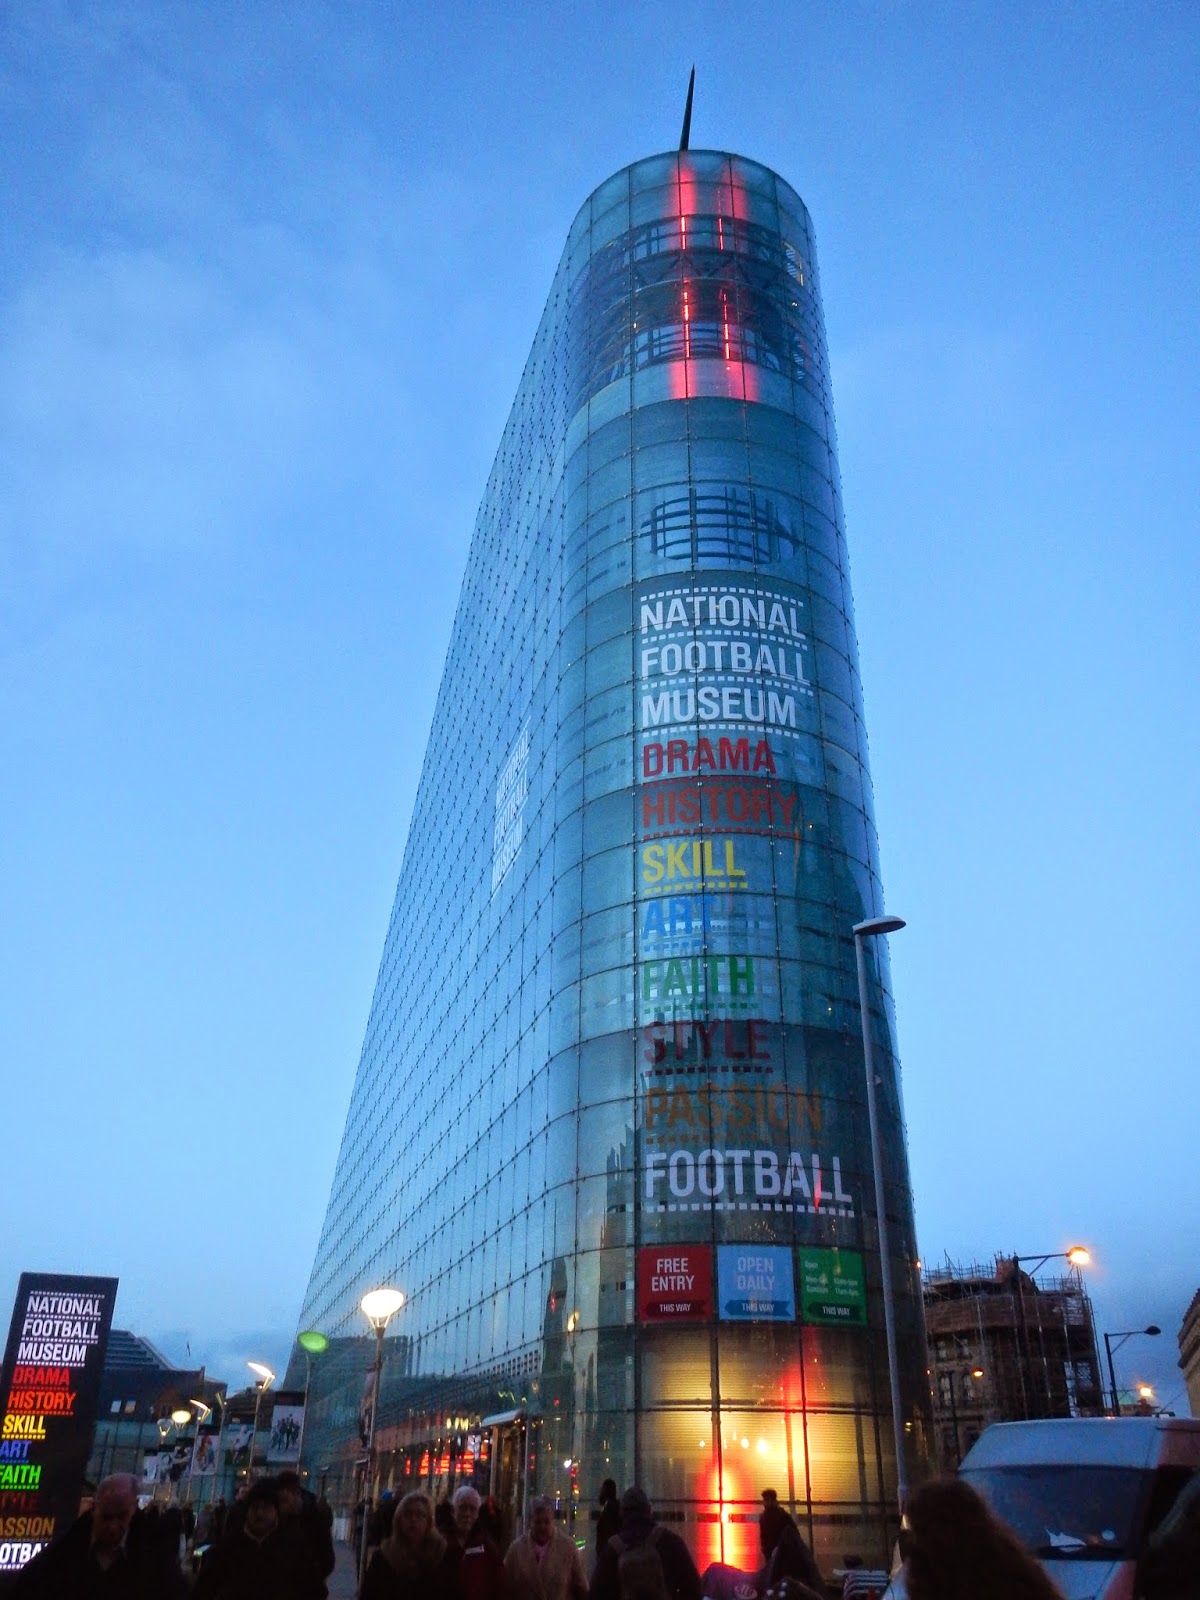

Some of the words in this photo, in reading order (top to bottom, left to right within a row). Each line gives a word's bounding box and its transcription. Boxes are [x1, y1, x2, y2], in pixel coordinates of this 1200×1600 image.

[640, 595, 806, 640] NATIONAL
[641, 640, 811, 686] FOOTBALL
[642, 686, 797, 728] MUSEUM
[642, 737, 777, 778] DRAMA
[642, 785, 797, 829] HISTORY
[642, 839, 746, 883] SKILL
[642, 895, 718, 941] ART
[643, 955, 755, 1001] FAITH
[644, 1018, 771, 1065] STYLE
[646, 1082, 823, 1132] PASSION
[645, 1149, 853, 1204] FOOTBALL
[656, 1257, 689, 1274] FREE
[737, 1256, 774, 1273] OPEN
[651, 1275, 695, 1292] ENTRY
[737, 1274, 775, 1291] DAILY
[26, 1295, 102, 1316] NATIONAL
[660, 1303, 675, 1313] THIS
[675, 1303, 691, 1312] WAY
[741, 1302, 758, 1312] THIS
[758, 1302, 775, 1312] WAY
[822, 1305, 836, 1315] THIS
[837, 1307, 850, 1316] WAY
[22, 1319, 99, 1339] FOOTBALL
[17, 1342, 87, 1362] MUSEUM
[13, 1366, 70, 1385] DRAMA
[8, 1391, 77, 1410] HISTORY
[3, 1414, 46, 1434] SKILL
[0, 1440, 32, 1458] ART
[0, 1516, 55, 1537] SSION
